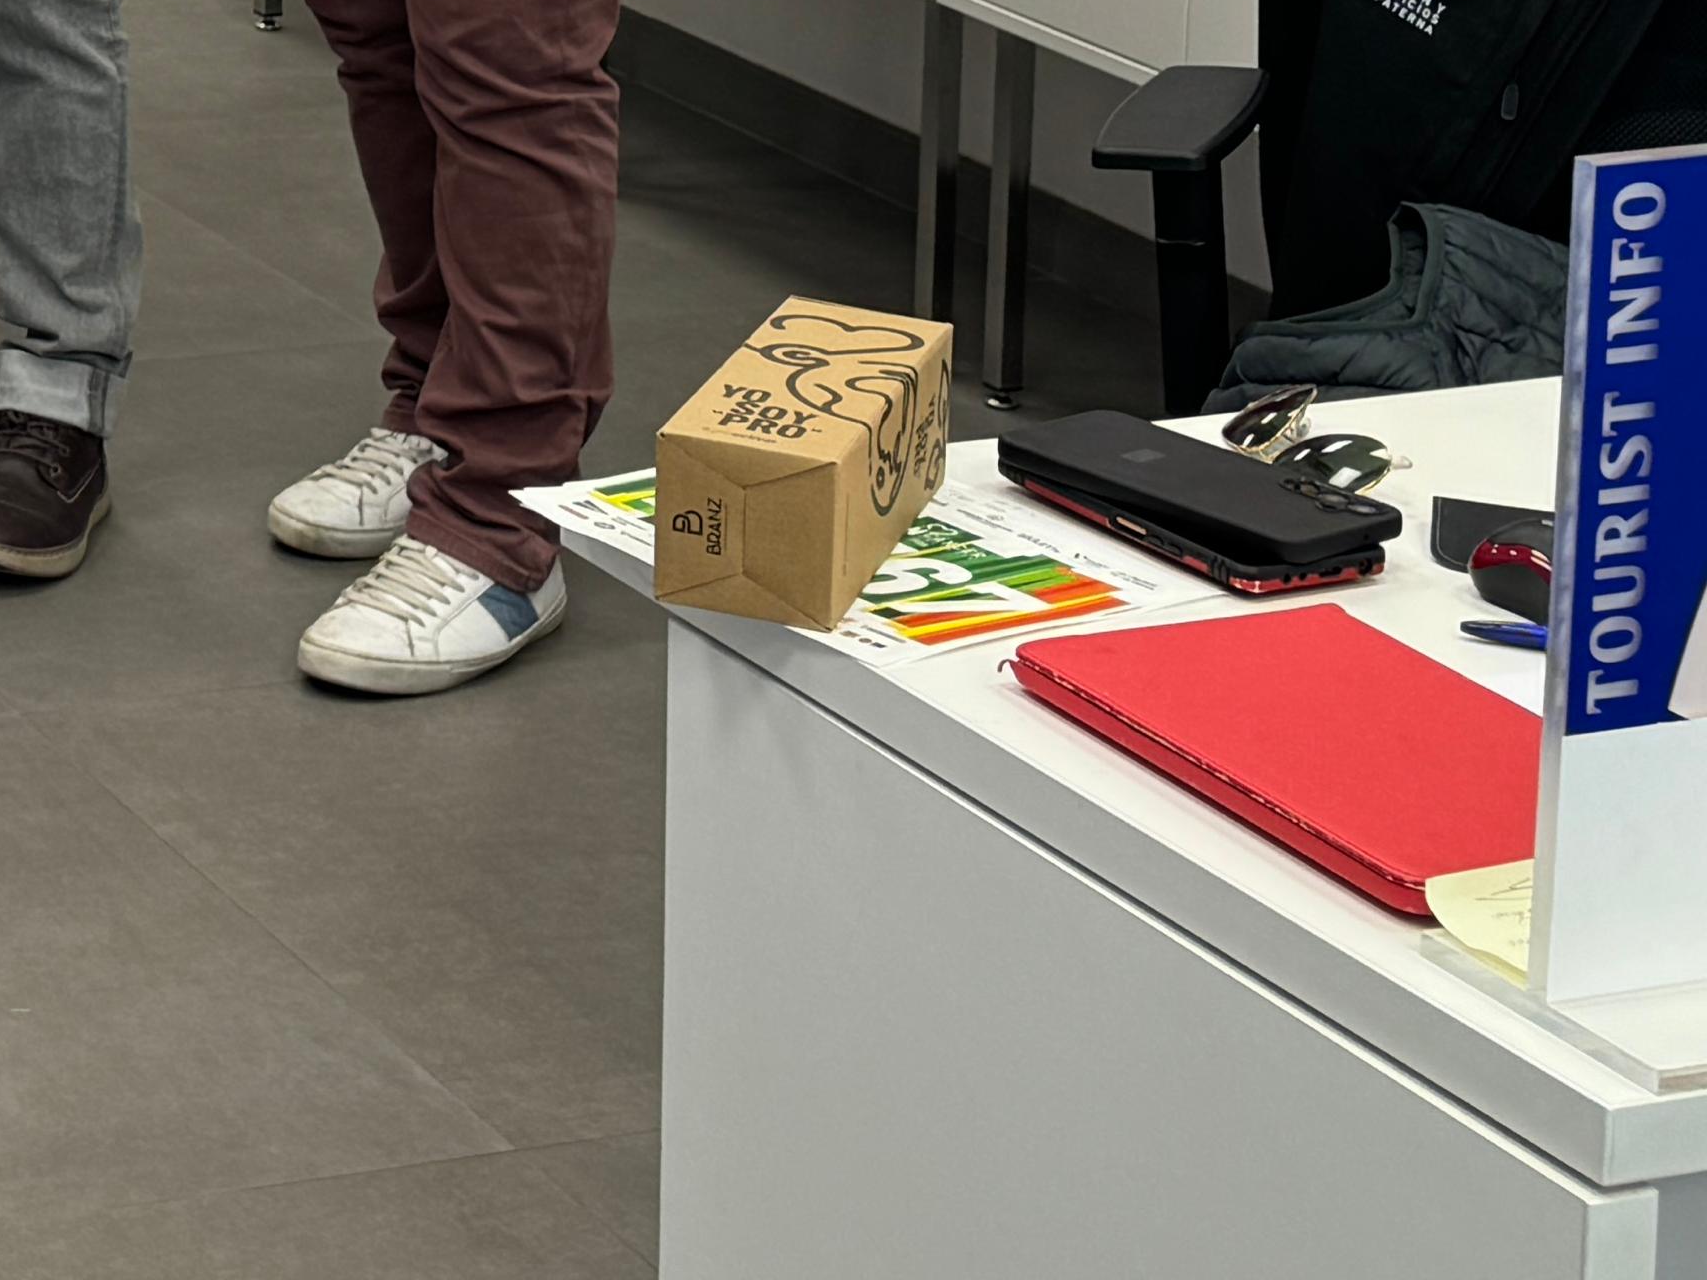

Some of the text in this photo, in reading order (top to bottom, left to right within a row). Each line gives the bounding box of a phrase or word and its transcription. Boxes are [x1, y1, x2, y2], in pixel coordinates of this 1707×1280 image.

[722, 383, 773, 404] YO
[730, 401, 820, 426] SOY
[1586, 180, 1667, 715] TOURIST INFO
